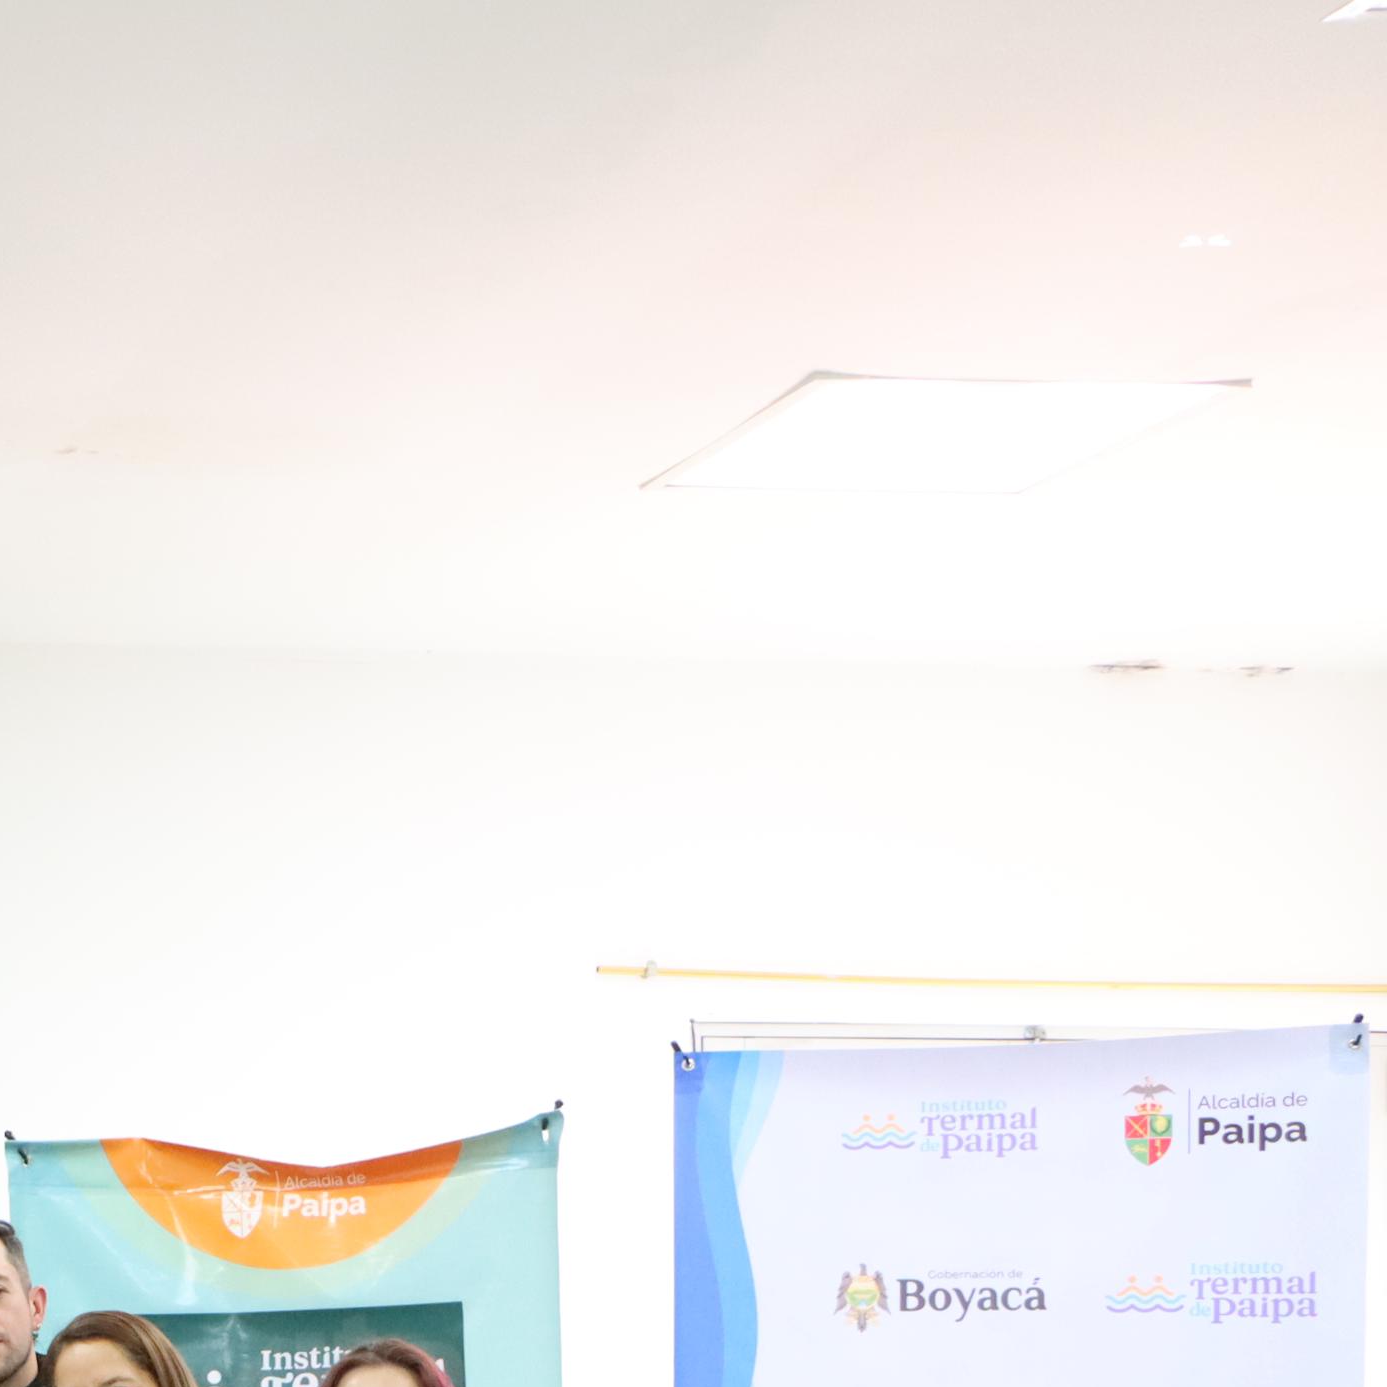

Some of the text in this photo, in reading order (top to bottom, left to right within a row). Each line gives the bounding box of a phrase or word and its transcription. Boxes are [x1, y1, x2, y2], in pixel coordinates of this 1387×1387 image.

[1282, 1091, 1308, 1108] de
[920, 1106, 1038, 1137] Termal
[1198, 1115, 1308, 1152] Paipa
[282, 1191, 366, 1228] Paipa
[1007, 1270, 1023, 1279] de
[1190, 1271, 1317, 1300] Termal
[896, 1277, 1047, 1323] Boyacá
